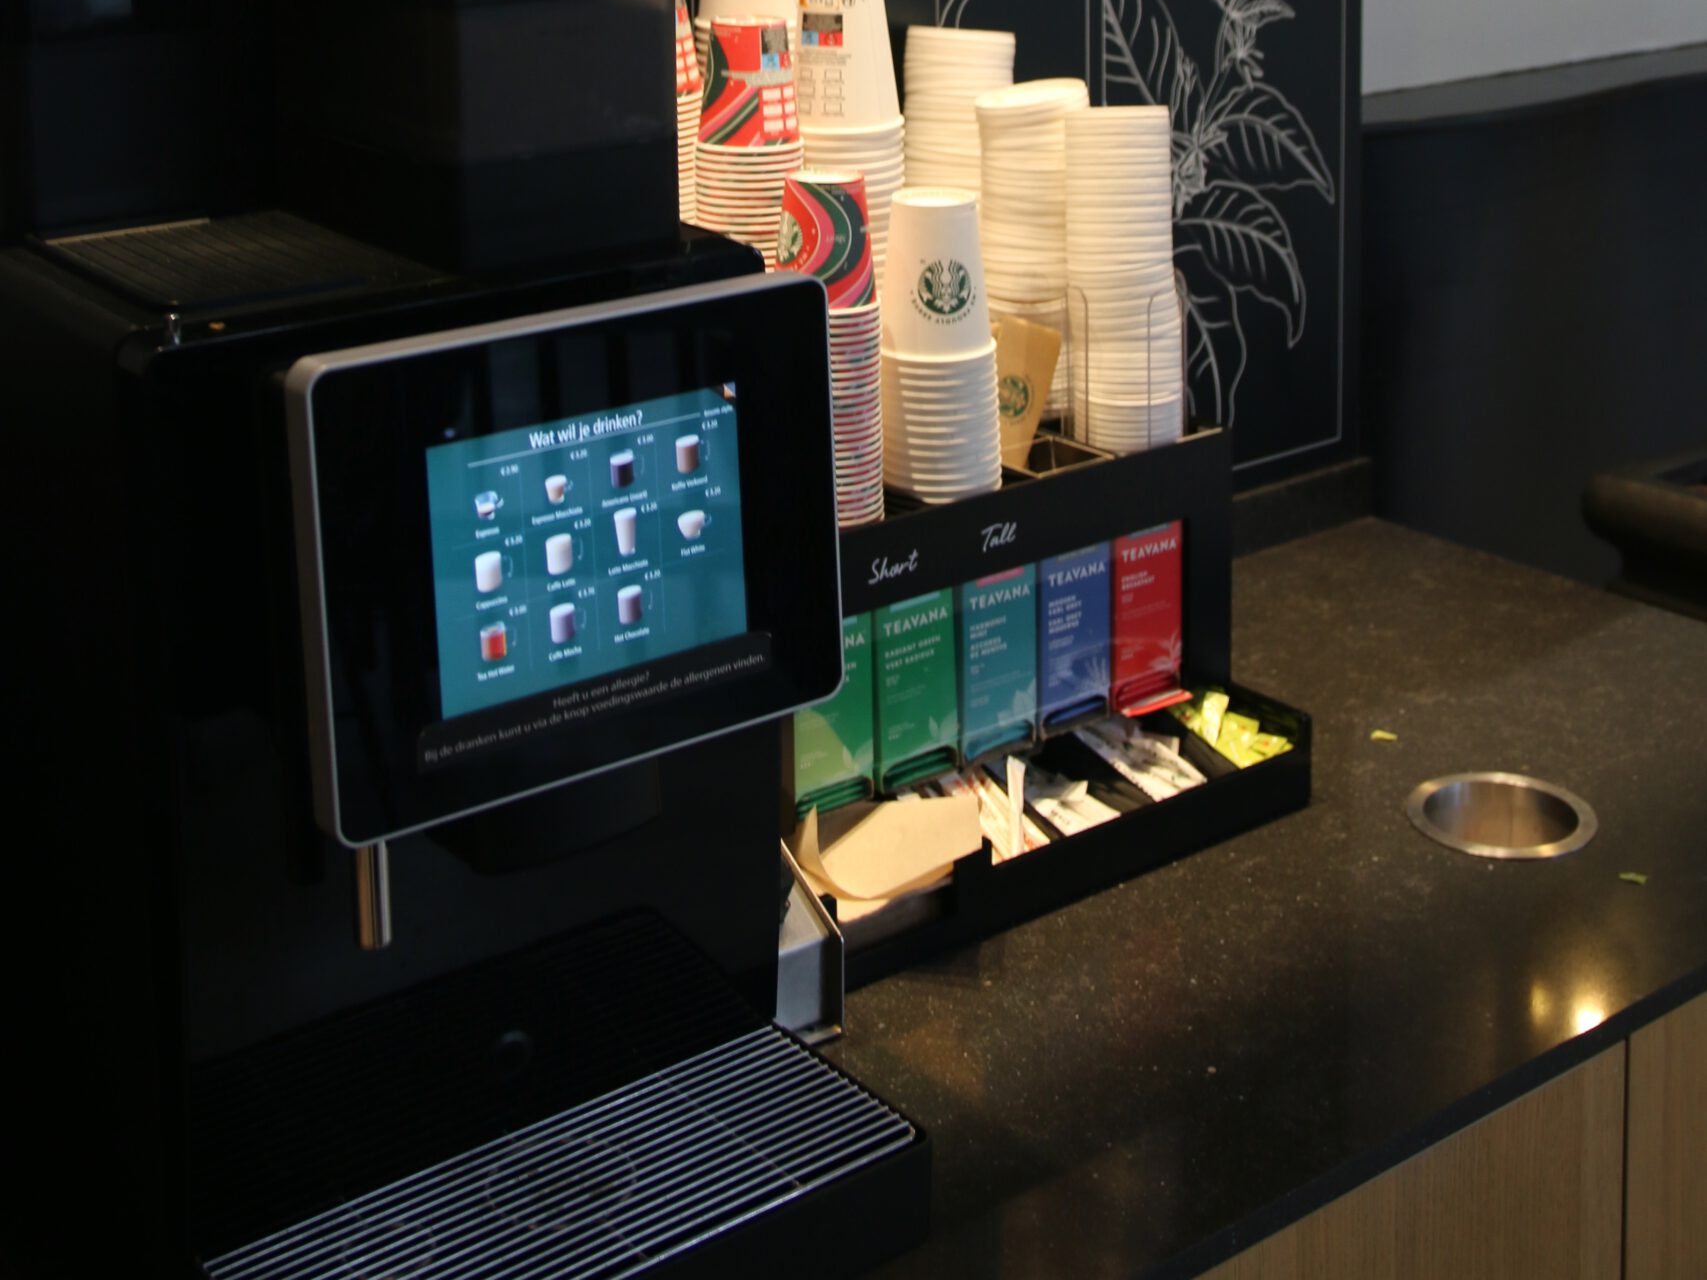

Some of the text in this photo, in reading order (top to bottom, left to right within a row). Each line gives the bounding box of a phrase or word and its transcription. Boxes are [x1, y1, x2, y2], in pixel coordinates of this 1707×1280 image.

[529, 409, 643, 449] Wat wil je drinken?
[868, 522, 1017, 586] Short Tall
[1121, 536, 1177, 564] TEAVANA
[1048, 561, 1106, 588] TEAVANA
[969, 583, 1031, 611] TEAVANA
[883, 605, 948, 638] TEAVANA
[424, 652, 767, 763] Bij de dranken kunt u via de knop voedingswaarde de allergenen vinden.
[552, 671, 650, 709] Heeft u een allergie?
